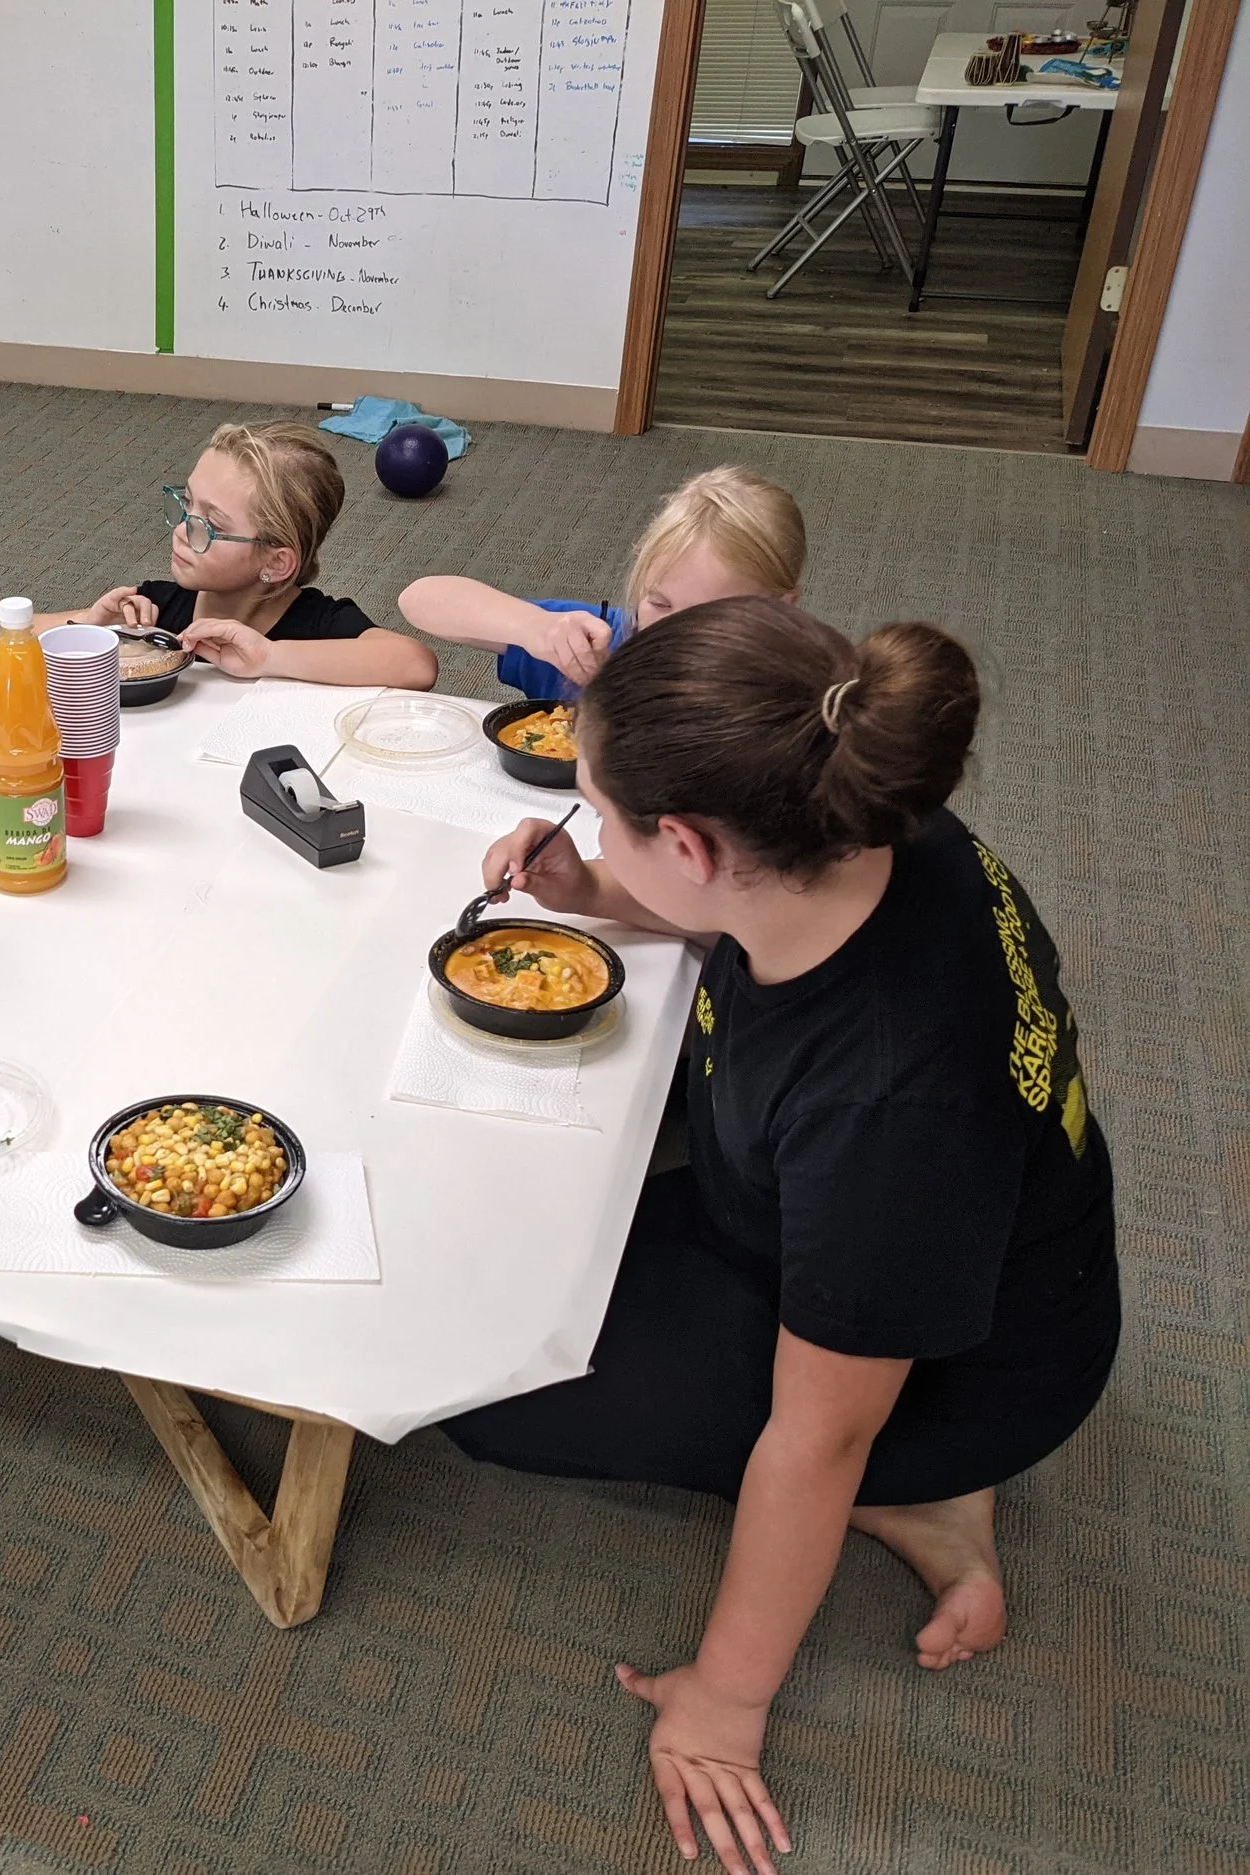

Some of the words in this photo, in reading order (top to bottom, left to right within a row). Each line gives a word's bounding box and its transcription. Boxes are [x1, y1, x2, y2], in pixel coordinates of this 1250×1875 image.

[218, 236, 230, 250] 2.
[247, 231, 295, 251] Diwali
[328, 233, 380, 249] November
[220, 266, 231, 279] 3.
[358, 268, 400, 285] November
[218, 296, 229, 311] 4.
[331, 295, 383, 315] December
[26, 800, 57, 820] SWAD
[4, 829, 37, 837] BEBIDA
[5, 832, 51, 846] MANGO
[993, 906, 1031, 1024] BLESSING
[1010, 1021, 1029, 1079] THE
[1017, 1024, 1048, 1099] KARI
